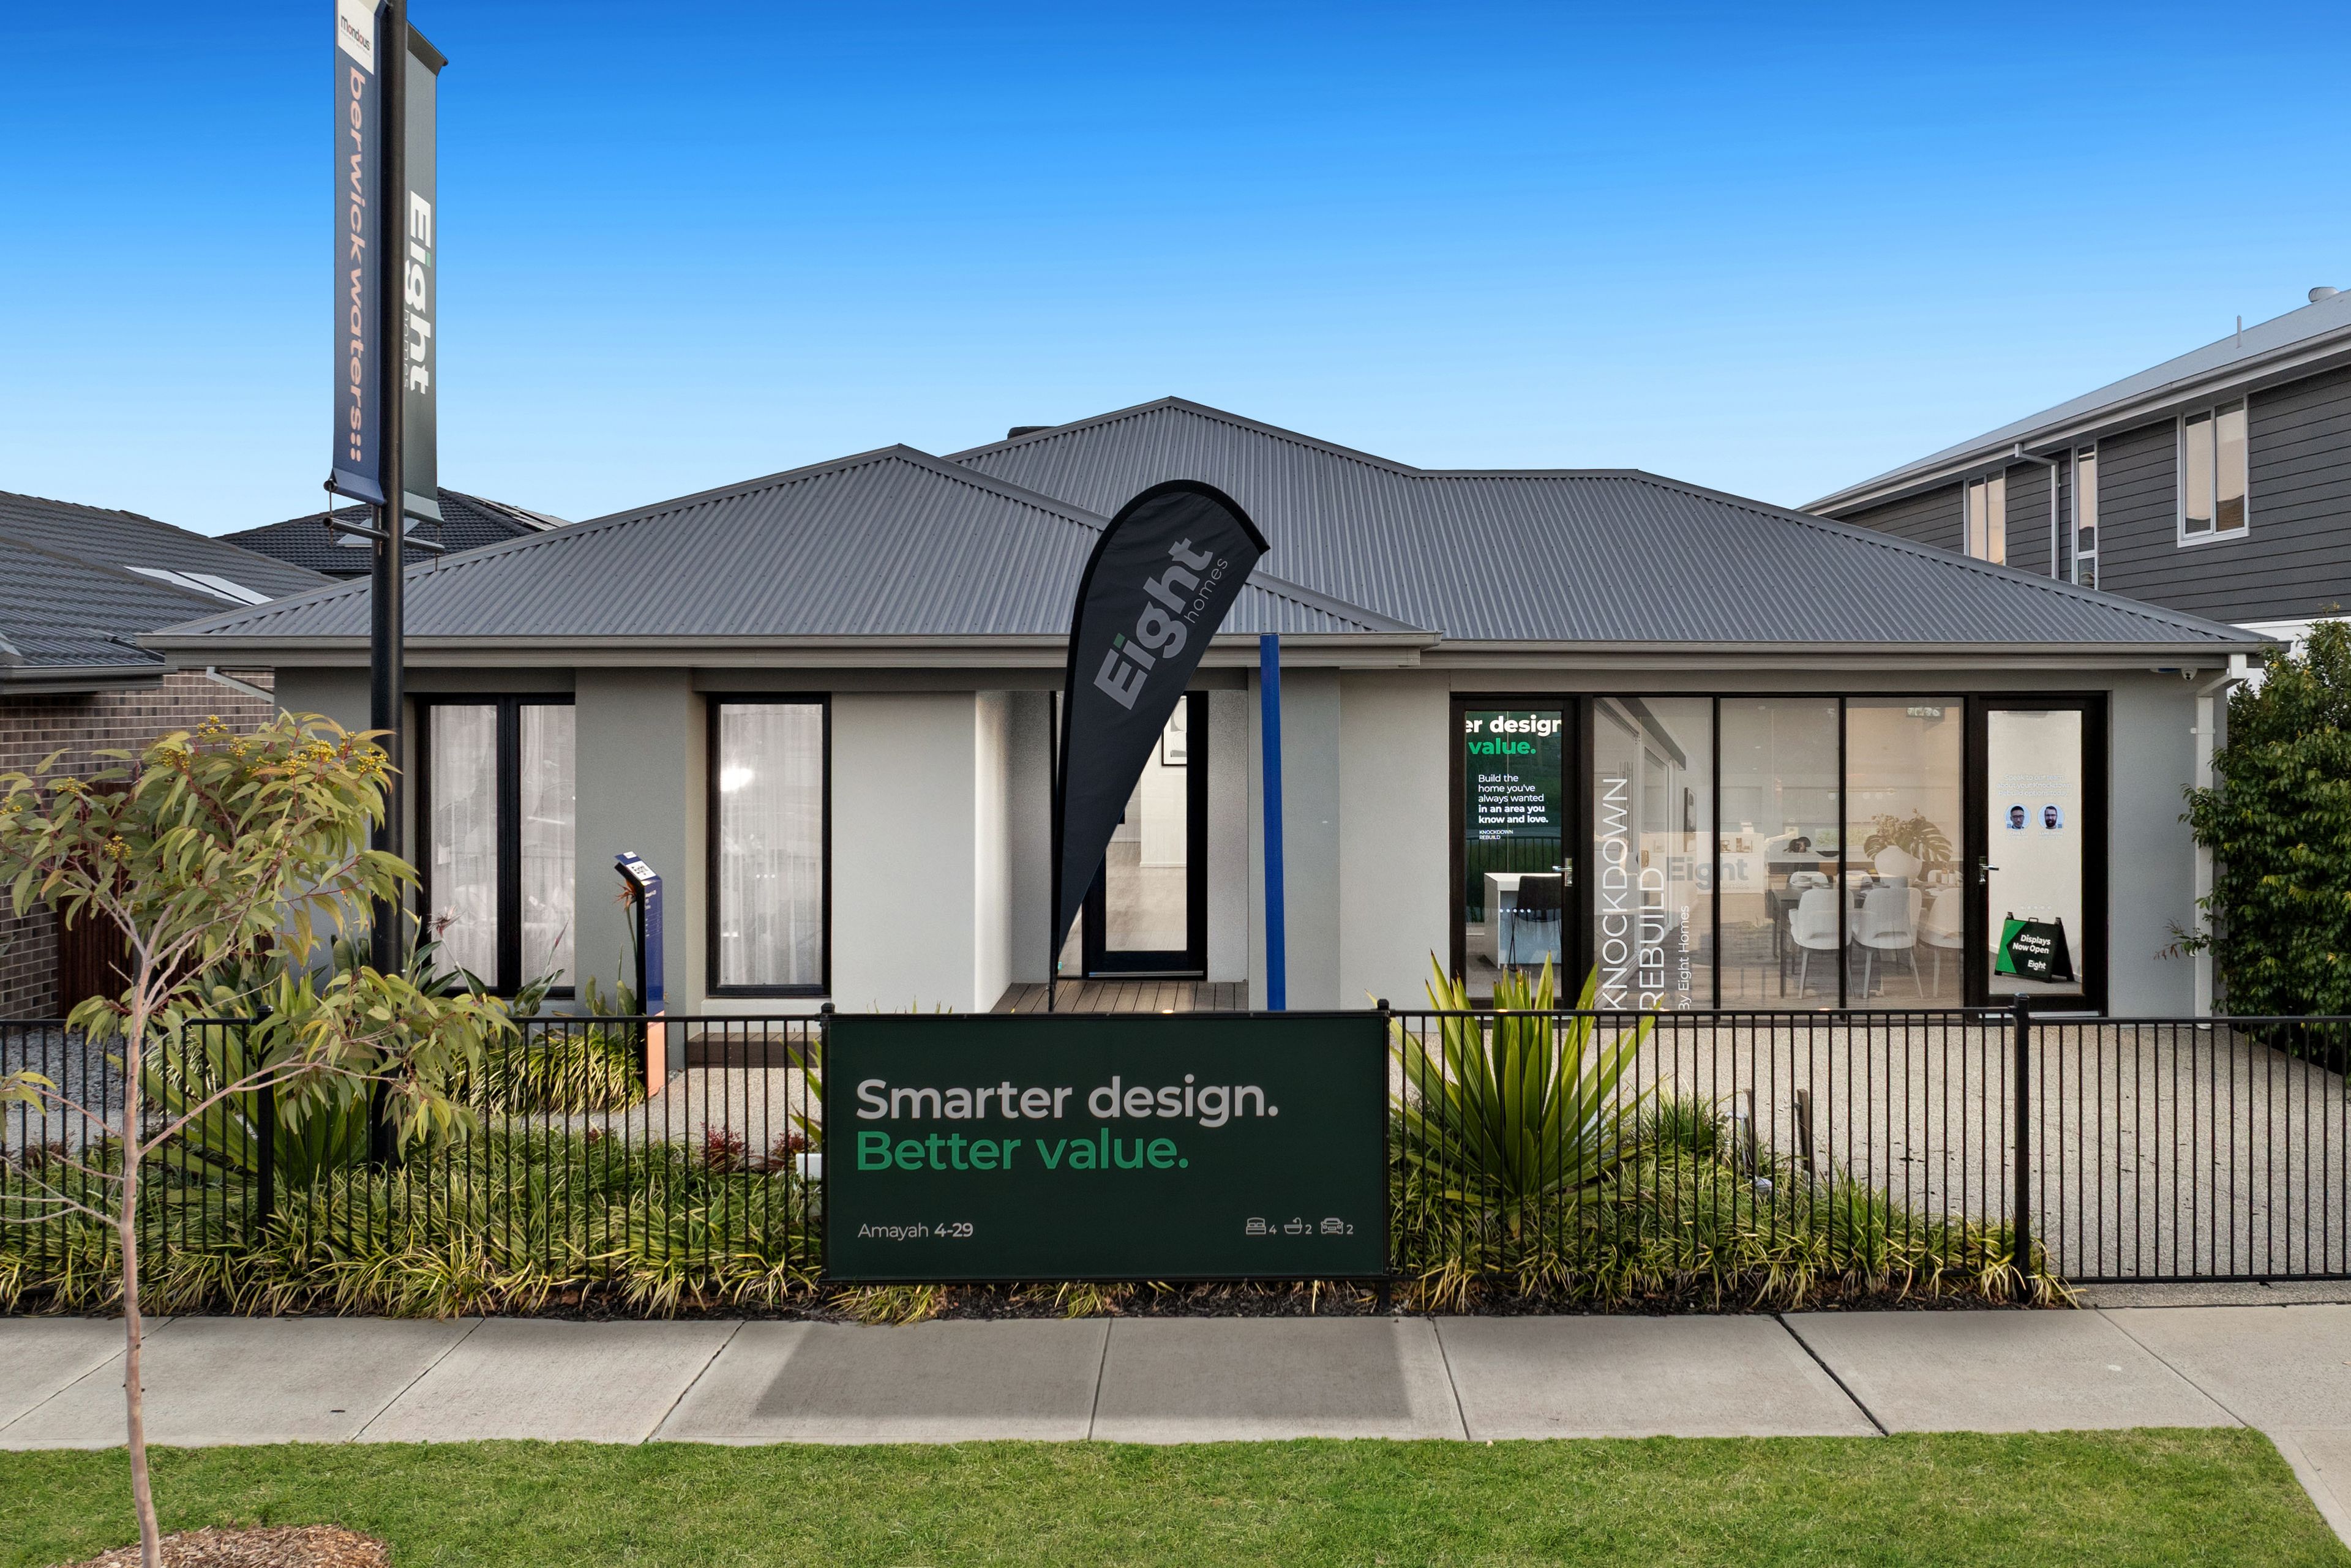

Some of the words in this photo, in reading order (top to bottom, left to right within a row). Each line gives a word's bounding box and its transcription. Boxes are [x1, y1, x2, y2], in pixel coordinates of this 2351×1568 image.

[340, 15, 370, 51] mondous
[405, 190, 431, 394] Eight
[1183, 558, 1229, 624] homes
[1093, 537, 1213, 711] Eight
[1468, 737, 1537, 754] value.
[1478, 774, 1501, 782] Build
[1503, 774, 1519, 782] the
[1478, 794, 1509, 804] always
[1510, 793, 1544, 803] wanted
[1507, 784, 1535, 794] you've
[1478, 805, 1488, 813] in
[1527, 806, 1545, 815] you
[1478, 815, 1505, 823] know
[1507, 815, 1525, 823] and
[1527, 815, 1549, 823] love.
[1667, 857, 1749, 890] Eight
[1602, 778, 1628, 1010] KNOCKDOWN
[1639, 867, 1665, 1010] REBUILD
[1678, 905, 1690, 953] Homes
[2012, 942, 2029, 951] Now
[2030, 945, 2049, 954] Open
[2020, 934, 2051, 946] Displays
[1678, 957, 1692, 991] Eight
[2028, 959, 2046, 970] Eight
[1678, 994, 1692, 1010] By
[856, 1079, 1073, 1120] Smarter
[1088, 1073, 1278, 1127] design.
[857, 1131, 1021, 1171] Better
[1035, 1127, 1189, 1169] value.
[857, 1222, 929, 1241] Amayah
[933, 1222, 974, 1237] 4-29
[1269, 1225, 1278, 1235] 4
[1305, 1224, 1312, 1235] 2
[1346, 1224, 1354, 1235] 2
